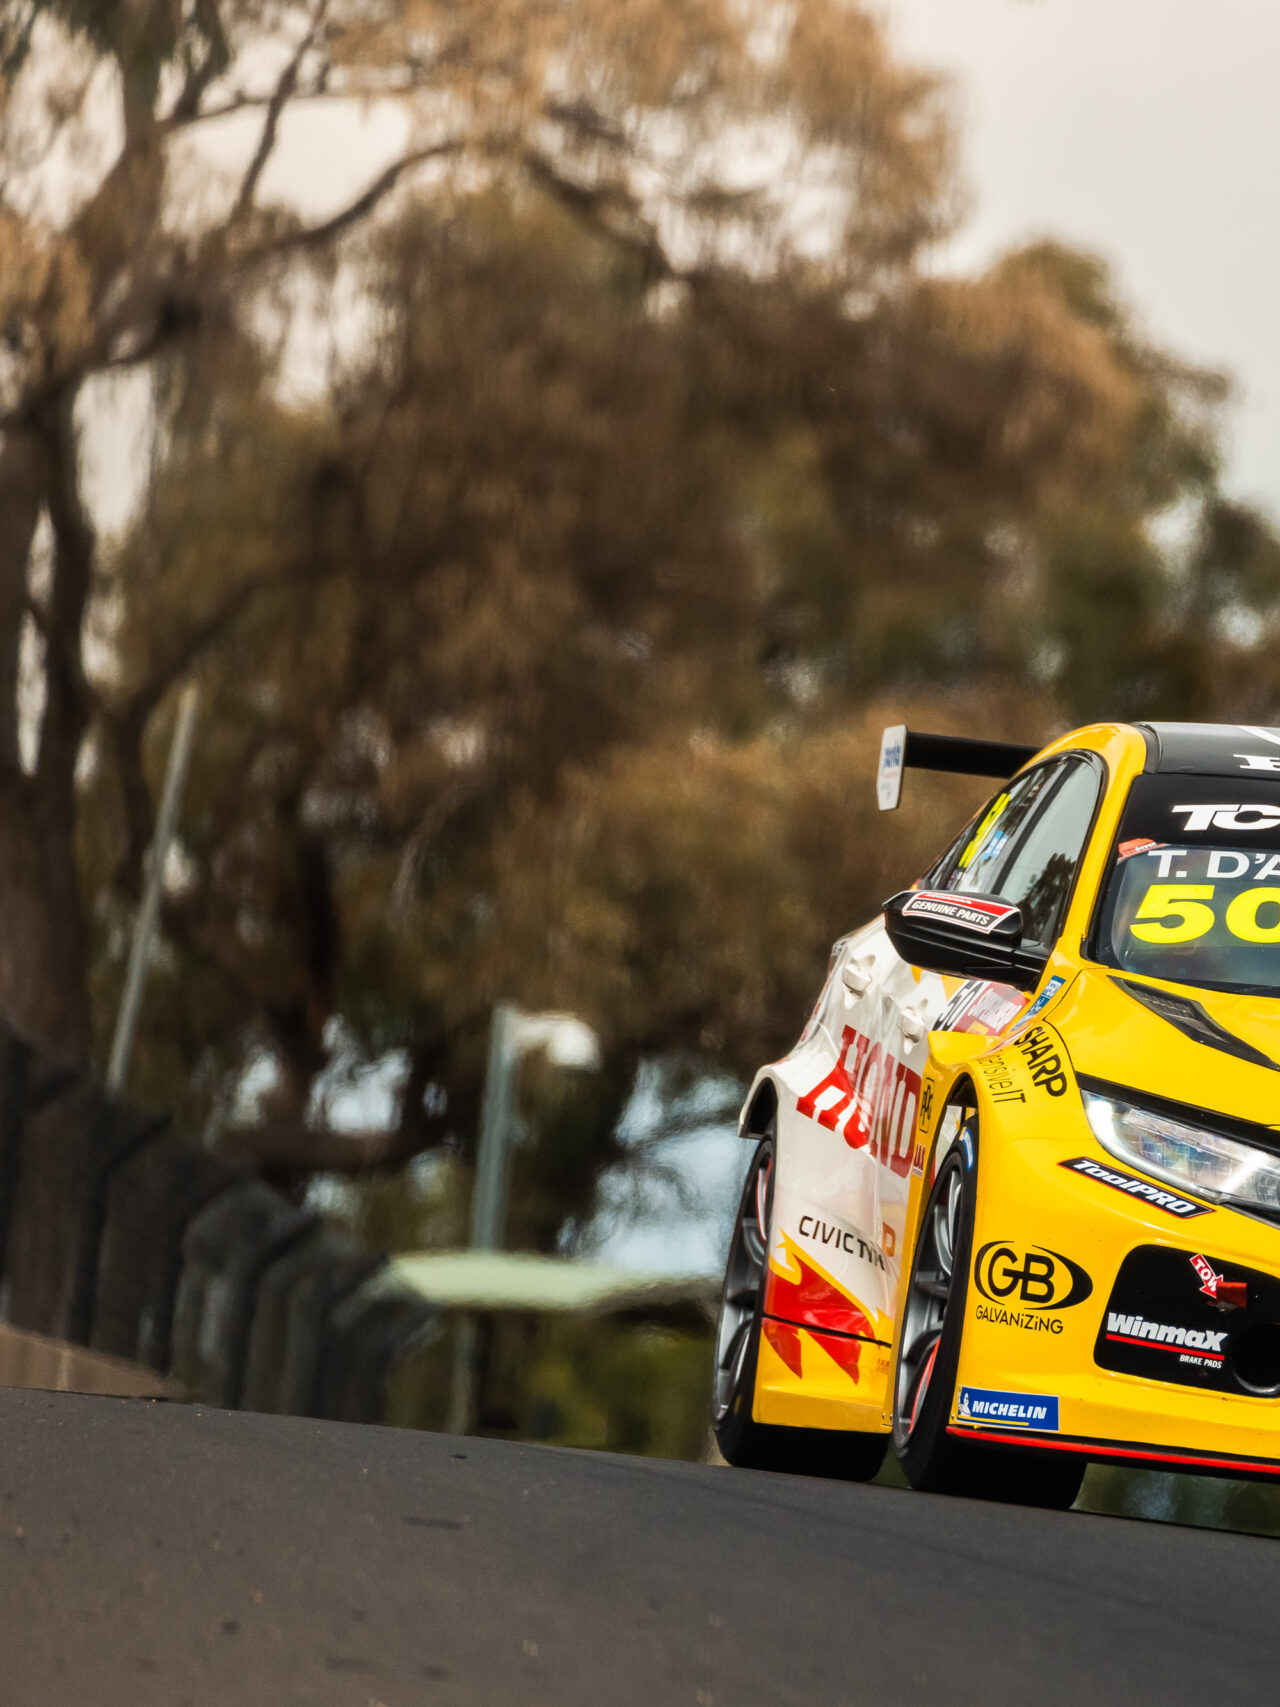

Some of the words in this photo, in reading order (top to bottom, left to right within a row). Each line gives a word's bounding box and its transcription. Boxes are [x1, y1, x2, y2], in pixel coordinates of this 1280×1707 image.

[1147, 849, 1188, 878] T.
[911, 900, 958, 917] GENUINE
[956, 908, 990, 925] PARTS
[1013, 1026, 1068, 1098] SHARP
[1072, 1159, 1197, 1214] ToolPRO
[987, 1247, 1055, 1304] GB
[1193, 1258, 1218, 1293] TOW
[1179, 1354, 1203, 1366] BRAKE
[1203, 1359, 1223, 1369] PADS
[971, 1400, 1048, 1420] MICHELIN
